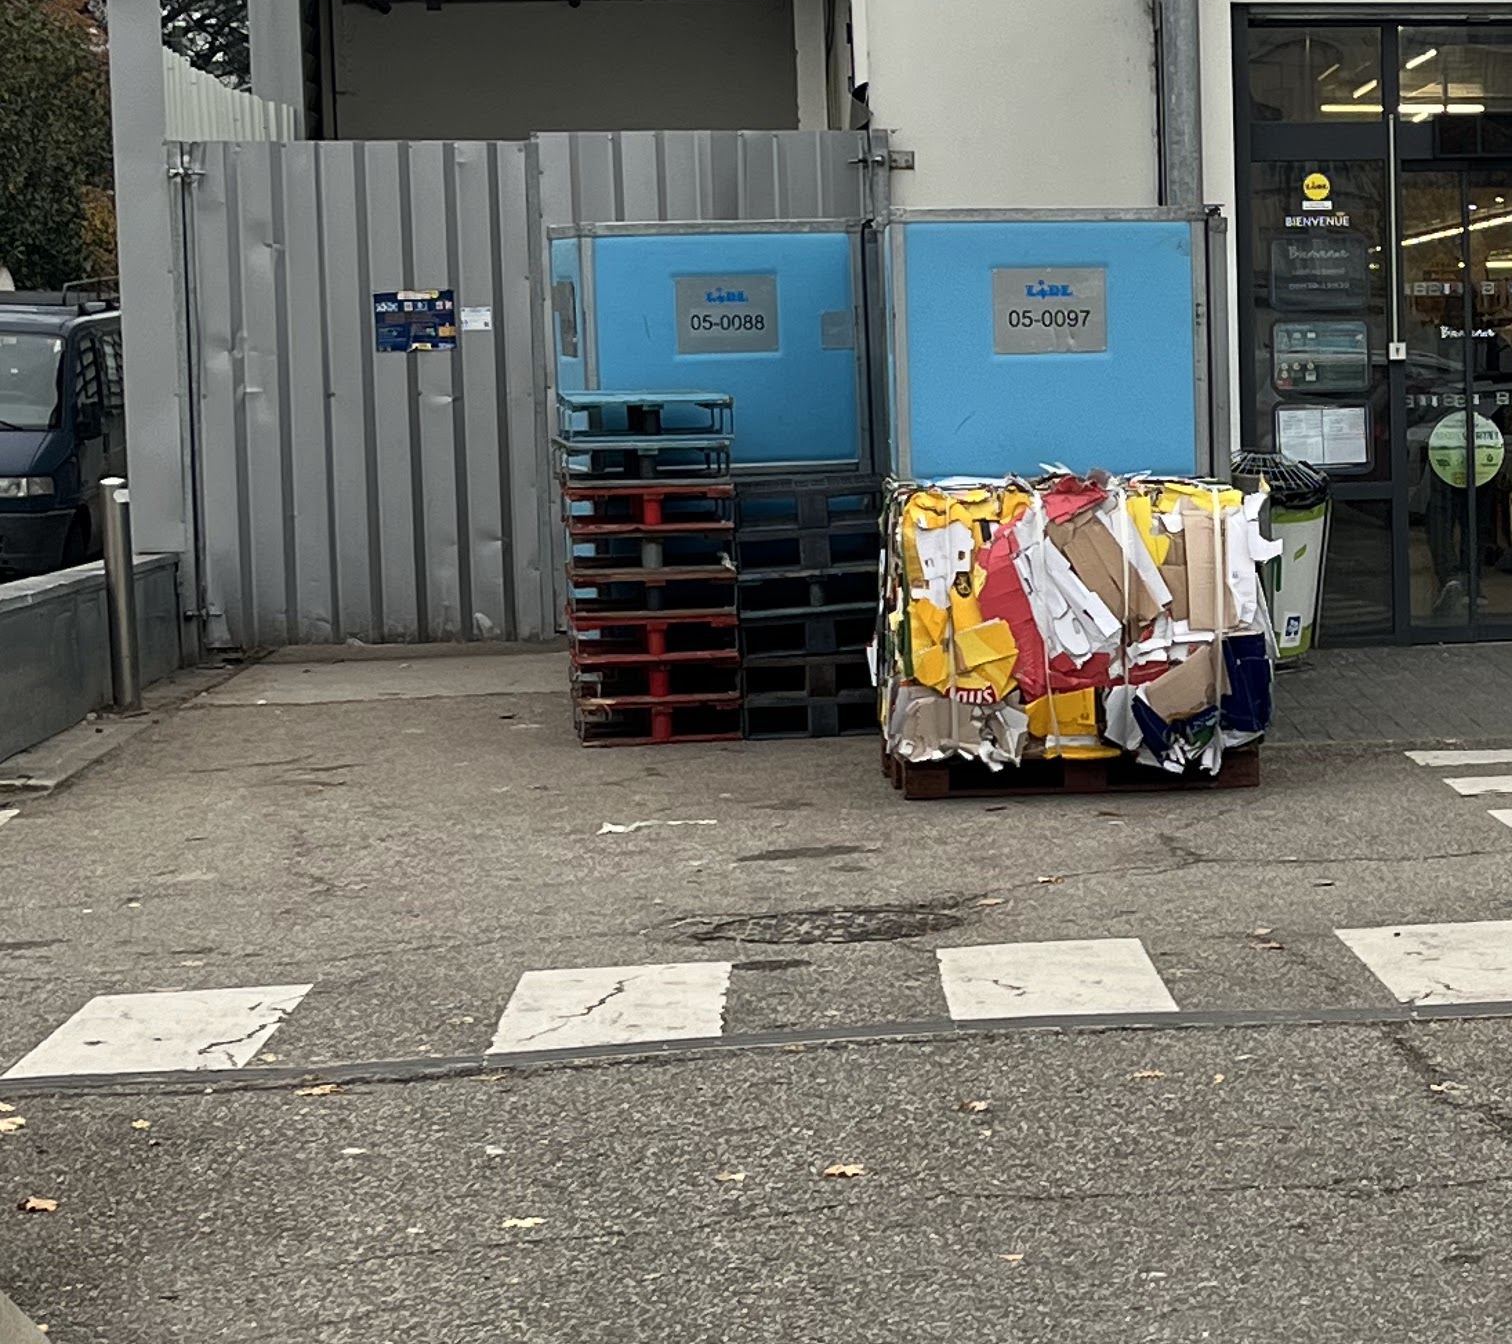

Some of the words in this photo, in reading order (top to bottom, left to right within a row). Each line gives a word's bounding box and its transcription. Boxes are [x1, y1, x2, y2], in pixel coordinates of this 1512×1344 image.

[1285, 216, 1350, 227] BIENVENUE
[690, 313, 765, 331] 05-0088
[1008, 309, 1091, 327] 05-0097
